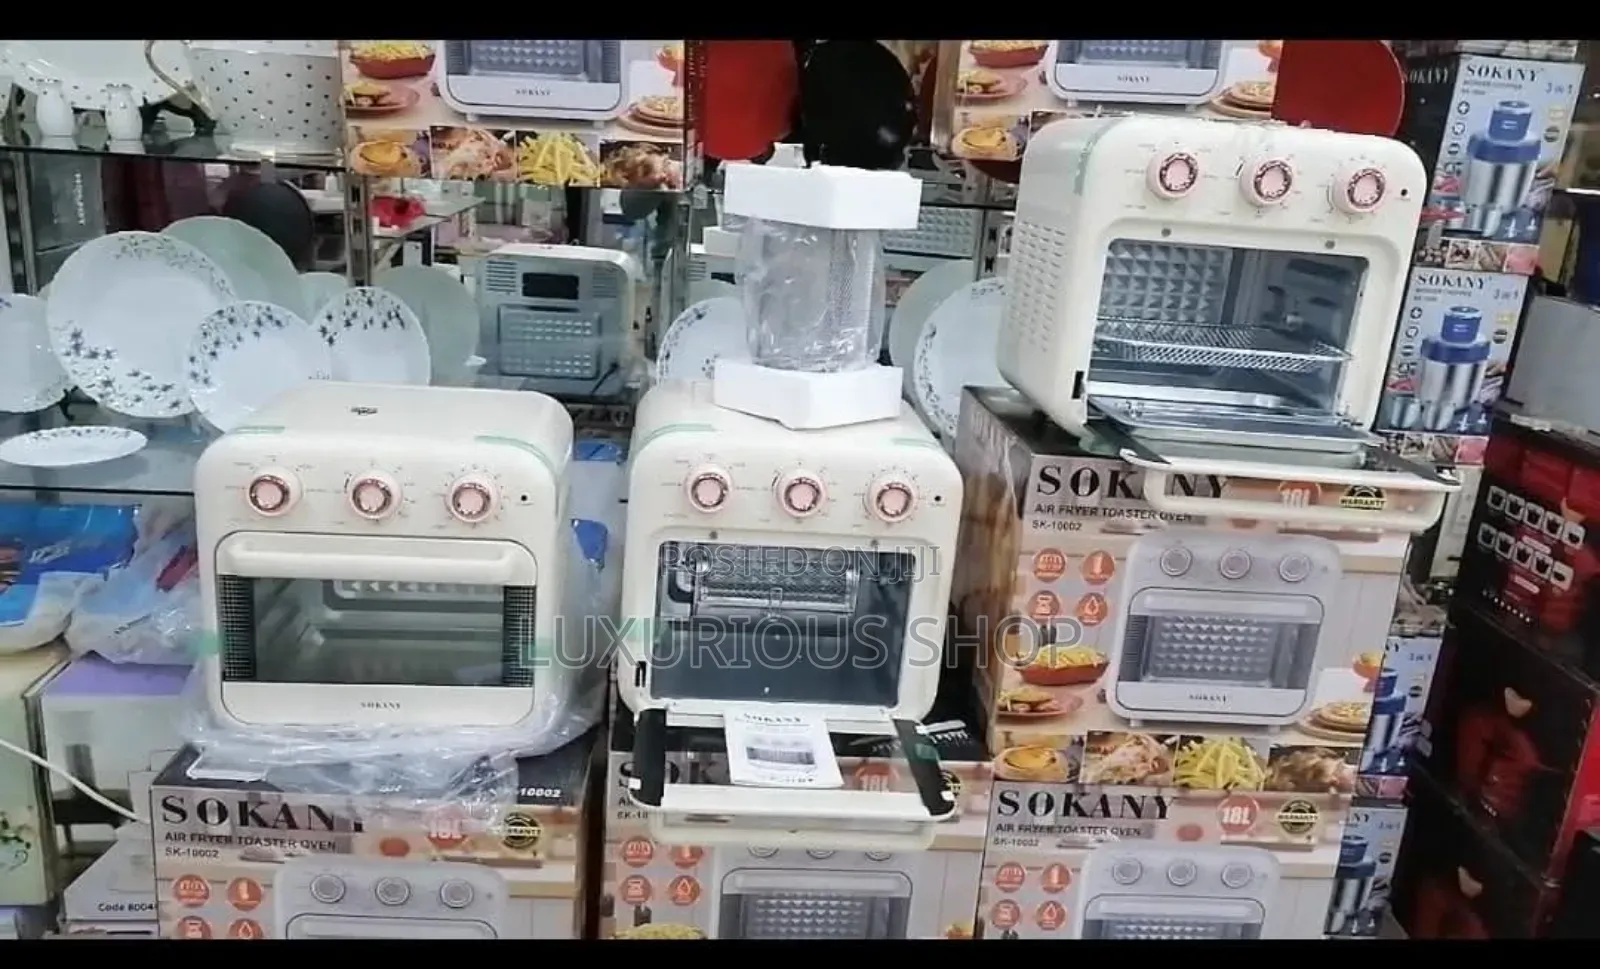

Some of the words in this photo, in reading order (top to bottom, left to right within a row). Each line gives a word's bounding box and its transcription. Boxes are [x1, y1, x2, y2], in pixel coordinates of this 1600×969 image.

[1467, 63, 1539, 82] SOKANY
[1418, 275, 1485, 289] SOKANY
[1037, 465, 1228, 499] SOKNY
[1034, 503, 1056, 515] AIR
[1059, 504, 1099, 518] FRYER
[1102, 506, 1157, 520] TOASTER
[1032, 519, 1082, 532] SK-10002
[998, 790, 1174, 819] SOKANY
[1222, 805, 1251, 825] 18L
[996, 823, 1015, 833] AIR
[1018, 824, 1054, 835] FRYER
[1055, 825, 1107, 837] TOASTER
[1110, 827, 1141, 837] OVEN
[165, 832, 187, 843] AIR
[190, 833, 233, 846] FRYER
[238, 834, 297, 849] TOASTER
[300, 838, 337, 851] OVEN
[98, 903, 125, 912] Code
